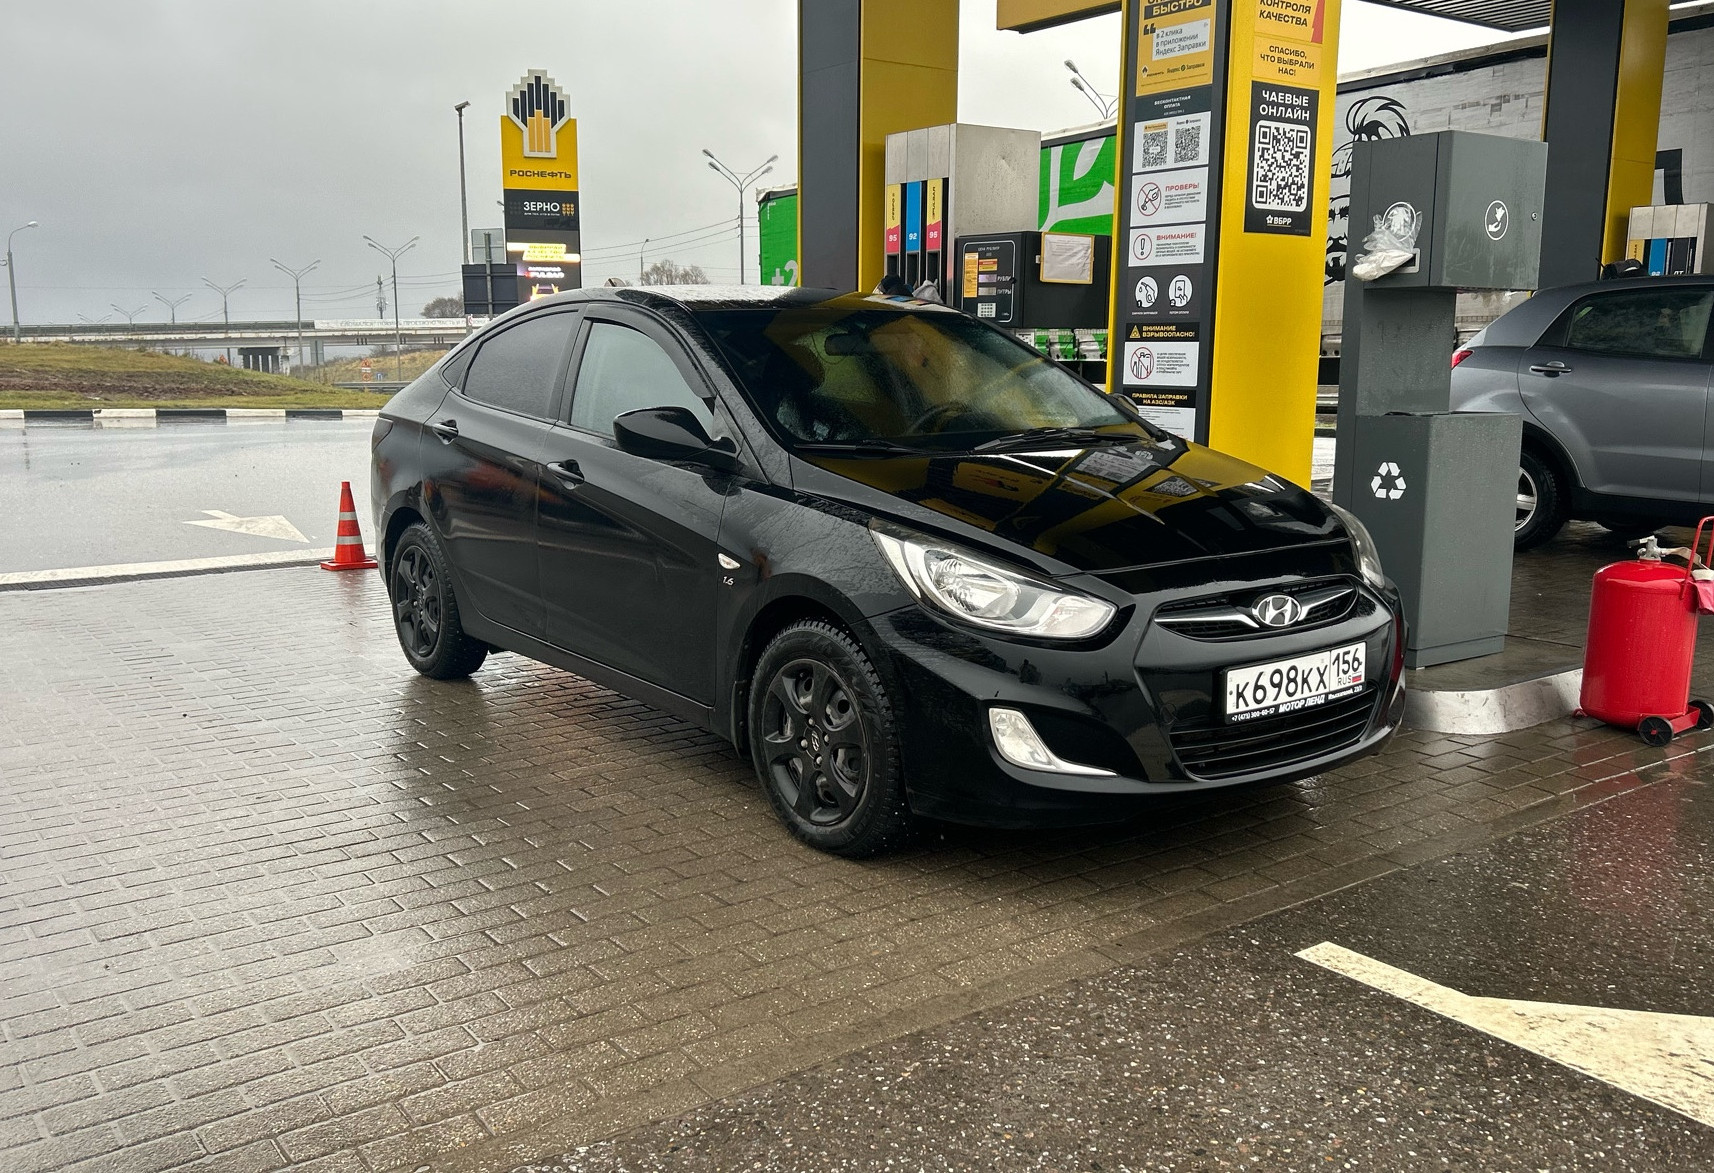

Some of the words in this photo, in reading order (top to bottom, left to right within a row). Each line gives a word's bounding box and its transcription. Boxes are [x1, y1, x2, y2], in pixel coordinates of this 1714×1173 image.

[1153, 0, 1203, 15] БЫСТРО
[1260, 0, 1311, 14] КОНТРОЛЯ
[1259, 10, 1308, 27] КАЧЕСТВА
[1165, 29, 1183, 37] клика
[1160, 34, 1199, 47] приложении
[1156, 47, 1176, 56] Яндекс
[1177, 41, 1206, 52] Заправки
[1269, 45, 1307, 59] СПАСИБО,
[1260, 54, 1275, 62] ЧТО
[1277, 57, 1314, 69] ВЫБРАЛИ
[1278, 67, 1296, 76] НАС!
[1262, 90, 1309, 106] ЧАЕВЫЕ
[1260, 104, 1310, 120] ОНЛАЙН
[510, 170, 572, 178] РОСНЕФТЬ
[1165, 183, 1200, 192] ПРОВЕРЬ!
[524, 202, 560, 212] ЗЕРНО
[1274, 217, 1292, 225] ВБРР
[1156, 232, 1197, 240] ВНИМАНИЕ!
[1236, 664, 1328, 709] К698КХ
[1332, 648, 1360, 677] 156
[1338, 675, 1352, 686] RUS
[1279, 700, 1305, 713] МОТОР
[1305, 694, 1325, 707] ЛЕНД
